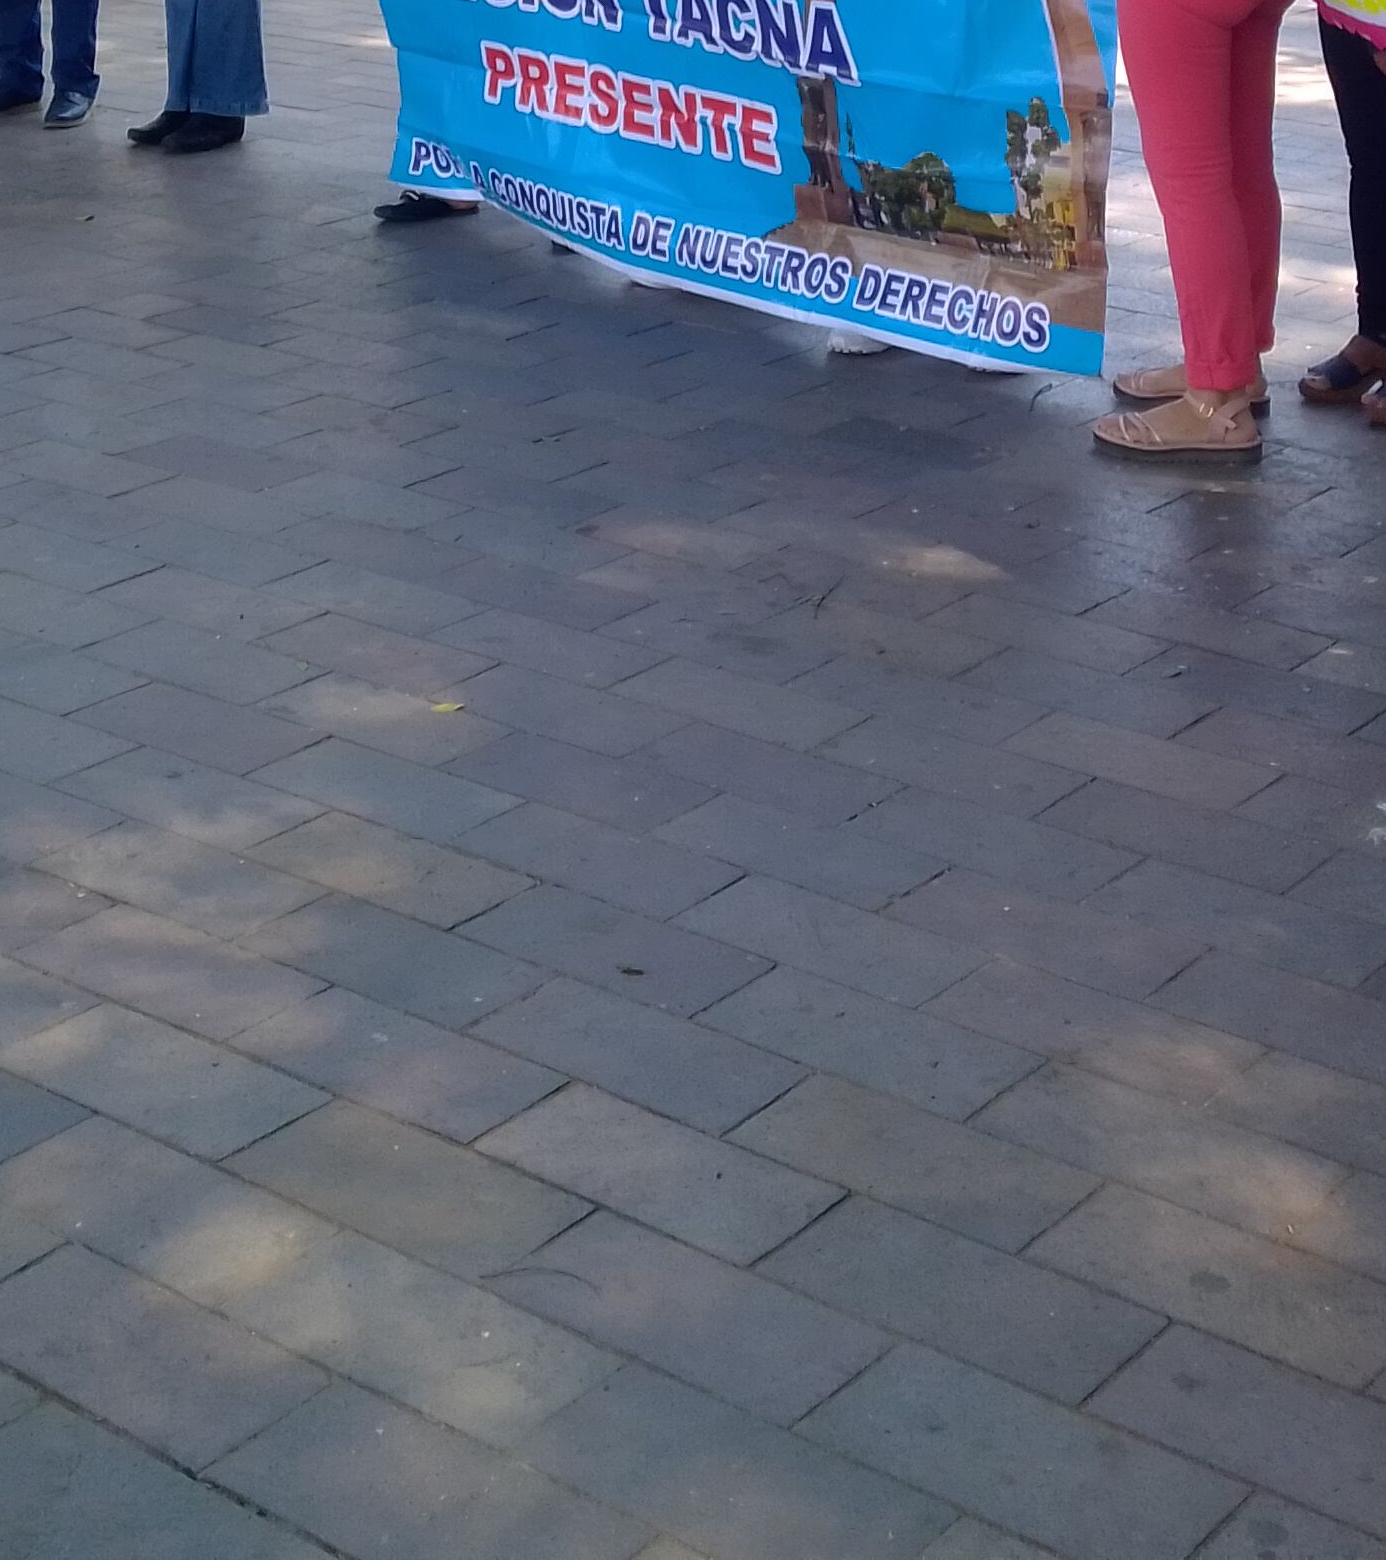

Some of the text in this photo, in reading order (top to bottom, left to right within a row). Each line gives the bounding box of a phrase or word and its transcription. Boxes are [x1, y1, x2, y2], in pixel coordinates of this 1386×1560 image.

[483, 46, 778, 171] PRESENTE
[489, 169, 623, 247] CONQUISTA
[631, 214, 671, 258] DE
[678, 226, 852, 299] NUESTROS
[855, 266, 1049, 350] DERECHOS
